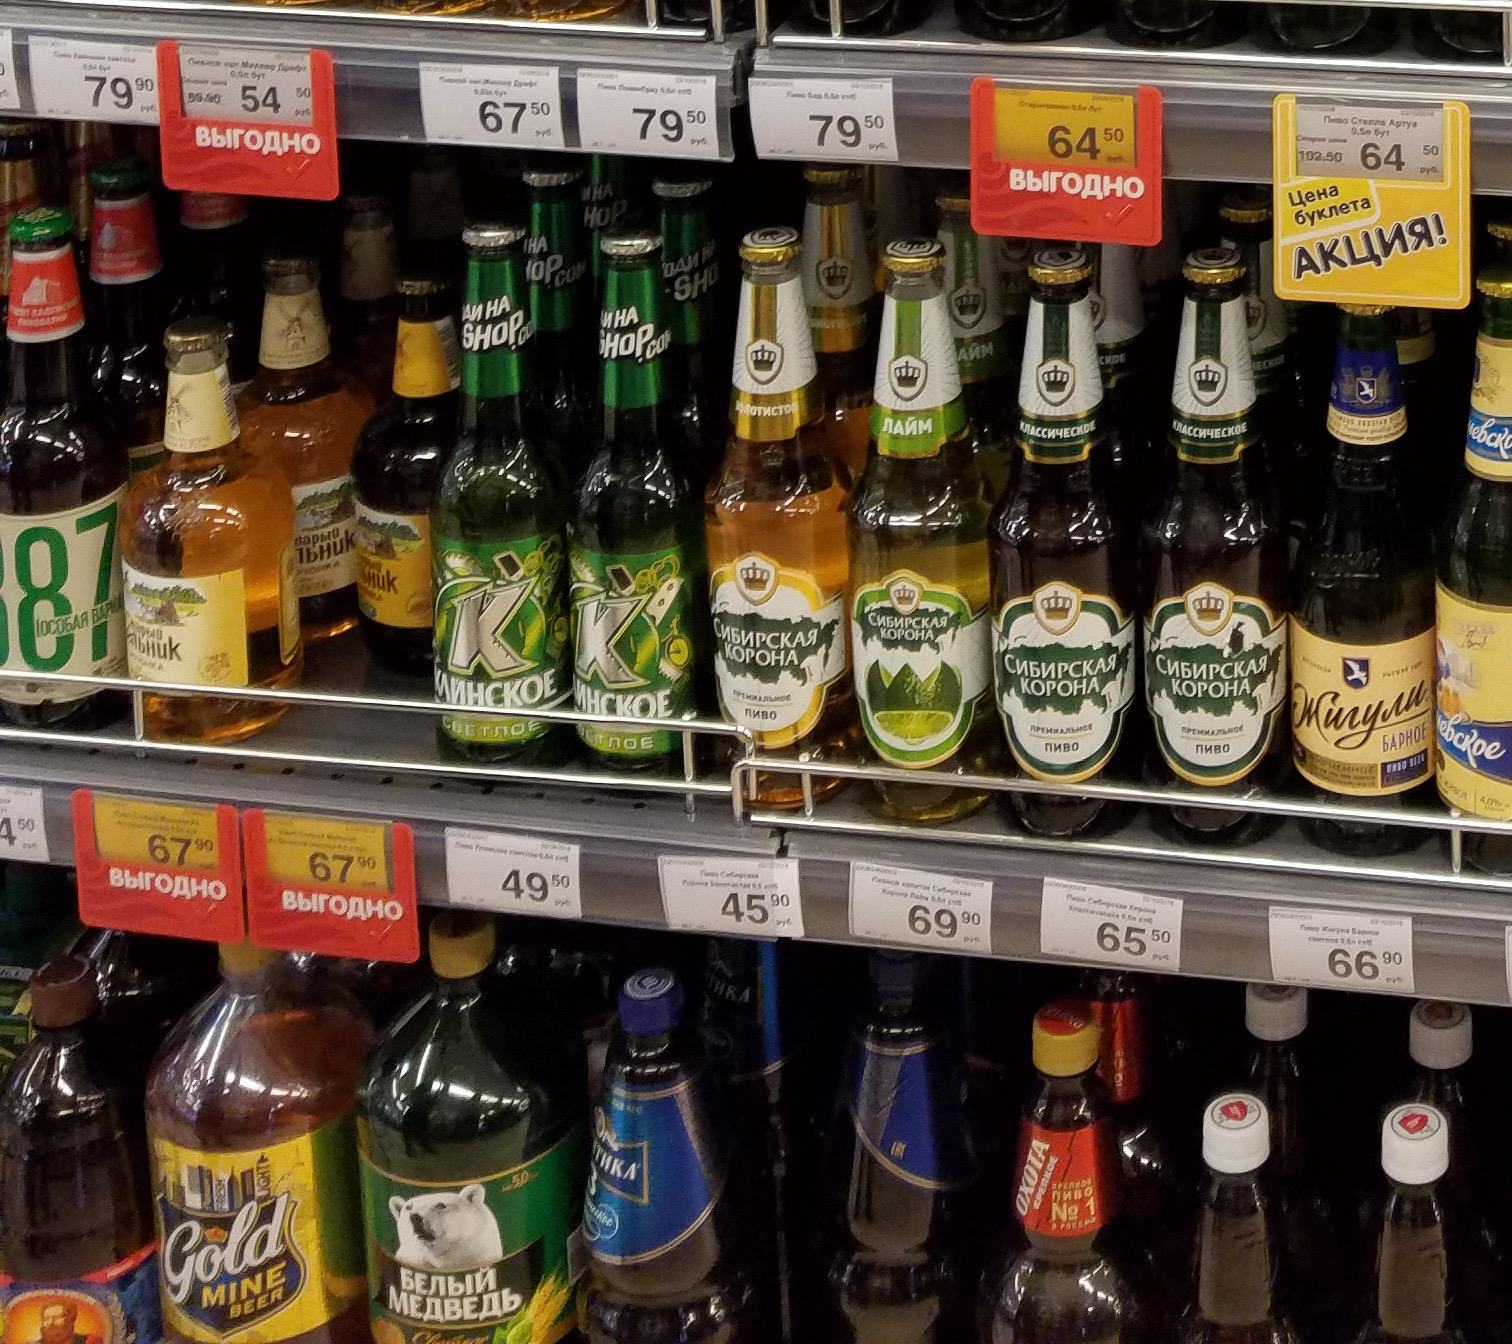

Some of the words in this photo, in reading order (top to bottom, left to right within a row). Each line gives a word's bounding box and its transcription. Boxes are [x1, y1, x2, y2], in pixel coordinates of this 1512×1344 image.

[479, 98, 528, 134] 67
[530, 102, 550, 117] 50
[195, 128, 320, 156] ВЫГОДНО
[808, 112, 861, 150] 79
[864, 114, 884, 131] 50
[1049, 124, 1100, 161] 64
[1102, 127, 1124, 142] 50
[1360, 142, 1405, 171] 64
[1423, 145, 1439, 155] 50
[1009, 168, 1145, 198] ВЫГОДНО
[1288, 184, 1339, 208] Цена
[1294, 197, 1371, 226] буклета
[1293, 214, 1447, 279] АКЦИЯ!
[881, 417, 934, 436] ЛАЙМ
[1020, 420, 1096, 441] КЛАССИЧЕСКОЕ
[1172, 420, 1248, 441] КЛАССИЧЕСКОЕ
[868, 613, 948, 632] СИБИРСКАЯ
[880, 624, 934, 642] КОРОНА
[1004, 653, 1116, 679] СИБИРСКАЯ
[1155, 653, 1268, 679] СИБИРСКАЯ
[1020, 674, 1100, 697] КОРОНА
[1172, 674, 1250, 698] КОРОНА
[1044, 741, 1080, 755] ПИВО
[1195, 741, 1230, 755] ПИВО
[1381, 723, 1428, 754] БАРНОЕ
[109, 867, 226, 901] ВЫГОДНО
[282, 891, 403, 921] ВЫГОДНО
[908, 906, 958, 938] 69
[960, 910, 981, 926] 90
[164, 1192, 292, 1301] Gold
[201, 1264, 286, 1308] MINE
[400, 1266, 498, 1294] БЕЛЫЙ
[230, 1291, 285, 1320] BEER
[389, 1292, 521, 1321] МЕДВЕДЬ
